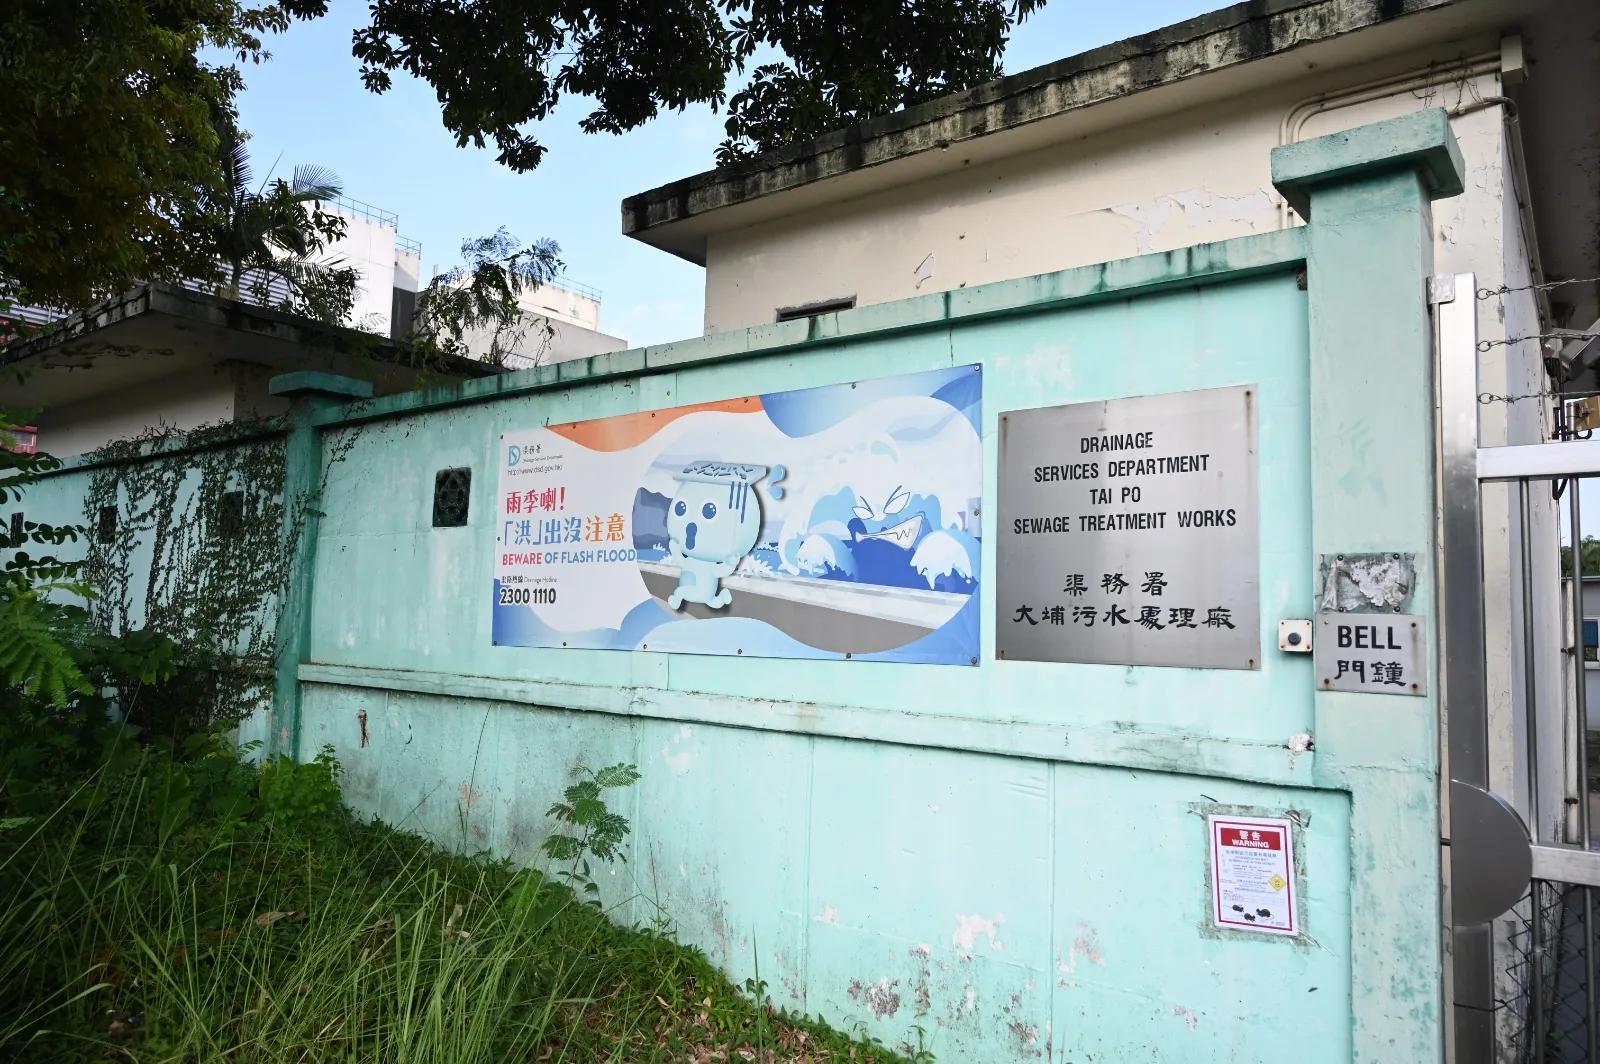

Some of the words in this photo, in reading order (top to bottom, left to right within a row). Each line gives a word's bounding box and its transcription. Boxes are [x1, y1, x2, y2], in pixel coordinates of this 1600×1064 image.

[1080, 432, 1153, 453] DRAINAGE
[1034, 463, 1099, 483] SERVICES
[1108, 454, 1210, 477] DEPARTMENT
[506, 486, 566, 514] 雨季喇！
[1090, 488, 1112, 505] TAI
[1121, 486, 1141, 503] PO
[504, 512, 625, 546] 「洪」出沒注意
[1014, 516, 1070, 534] SEWAGE
[1079, 512, 1167, 532] TREATMENT
[1178, 508, 1236, 528] WORKS
[502, 552, 543, 566] BEWARE
[544, 552, 559, 565] OF
[561, 550, 594, 564] FLASH
[597, 548, 636, 563] FLOOD
[500, 588, 530, 604] 2300
[533, 587, 557, 604] 1110
[1063, 571, 1168, 597] 渠務署
[1012, 604, 1237, 631] 大埔污水處理廠
[1338, 625, 1402, 650] BELL
[1334, 660, 1407, 687] 門鐘
[1231, 839, 1270, 849] WARNING
[1239, 830, 1261, 841] 警告
